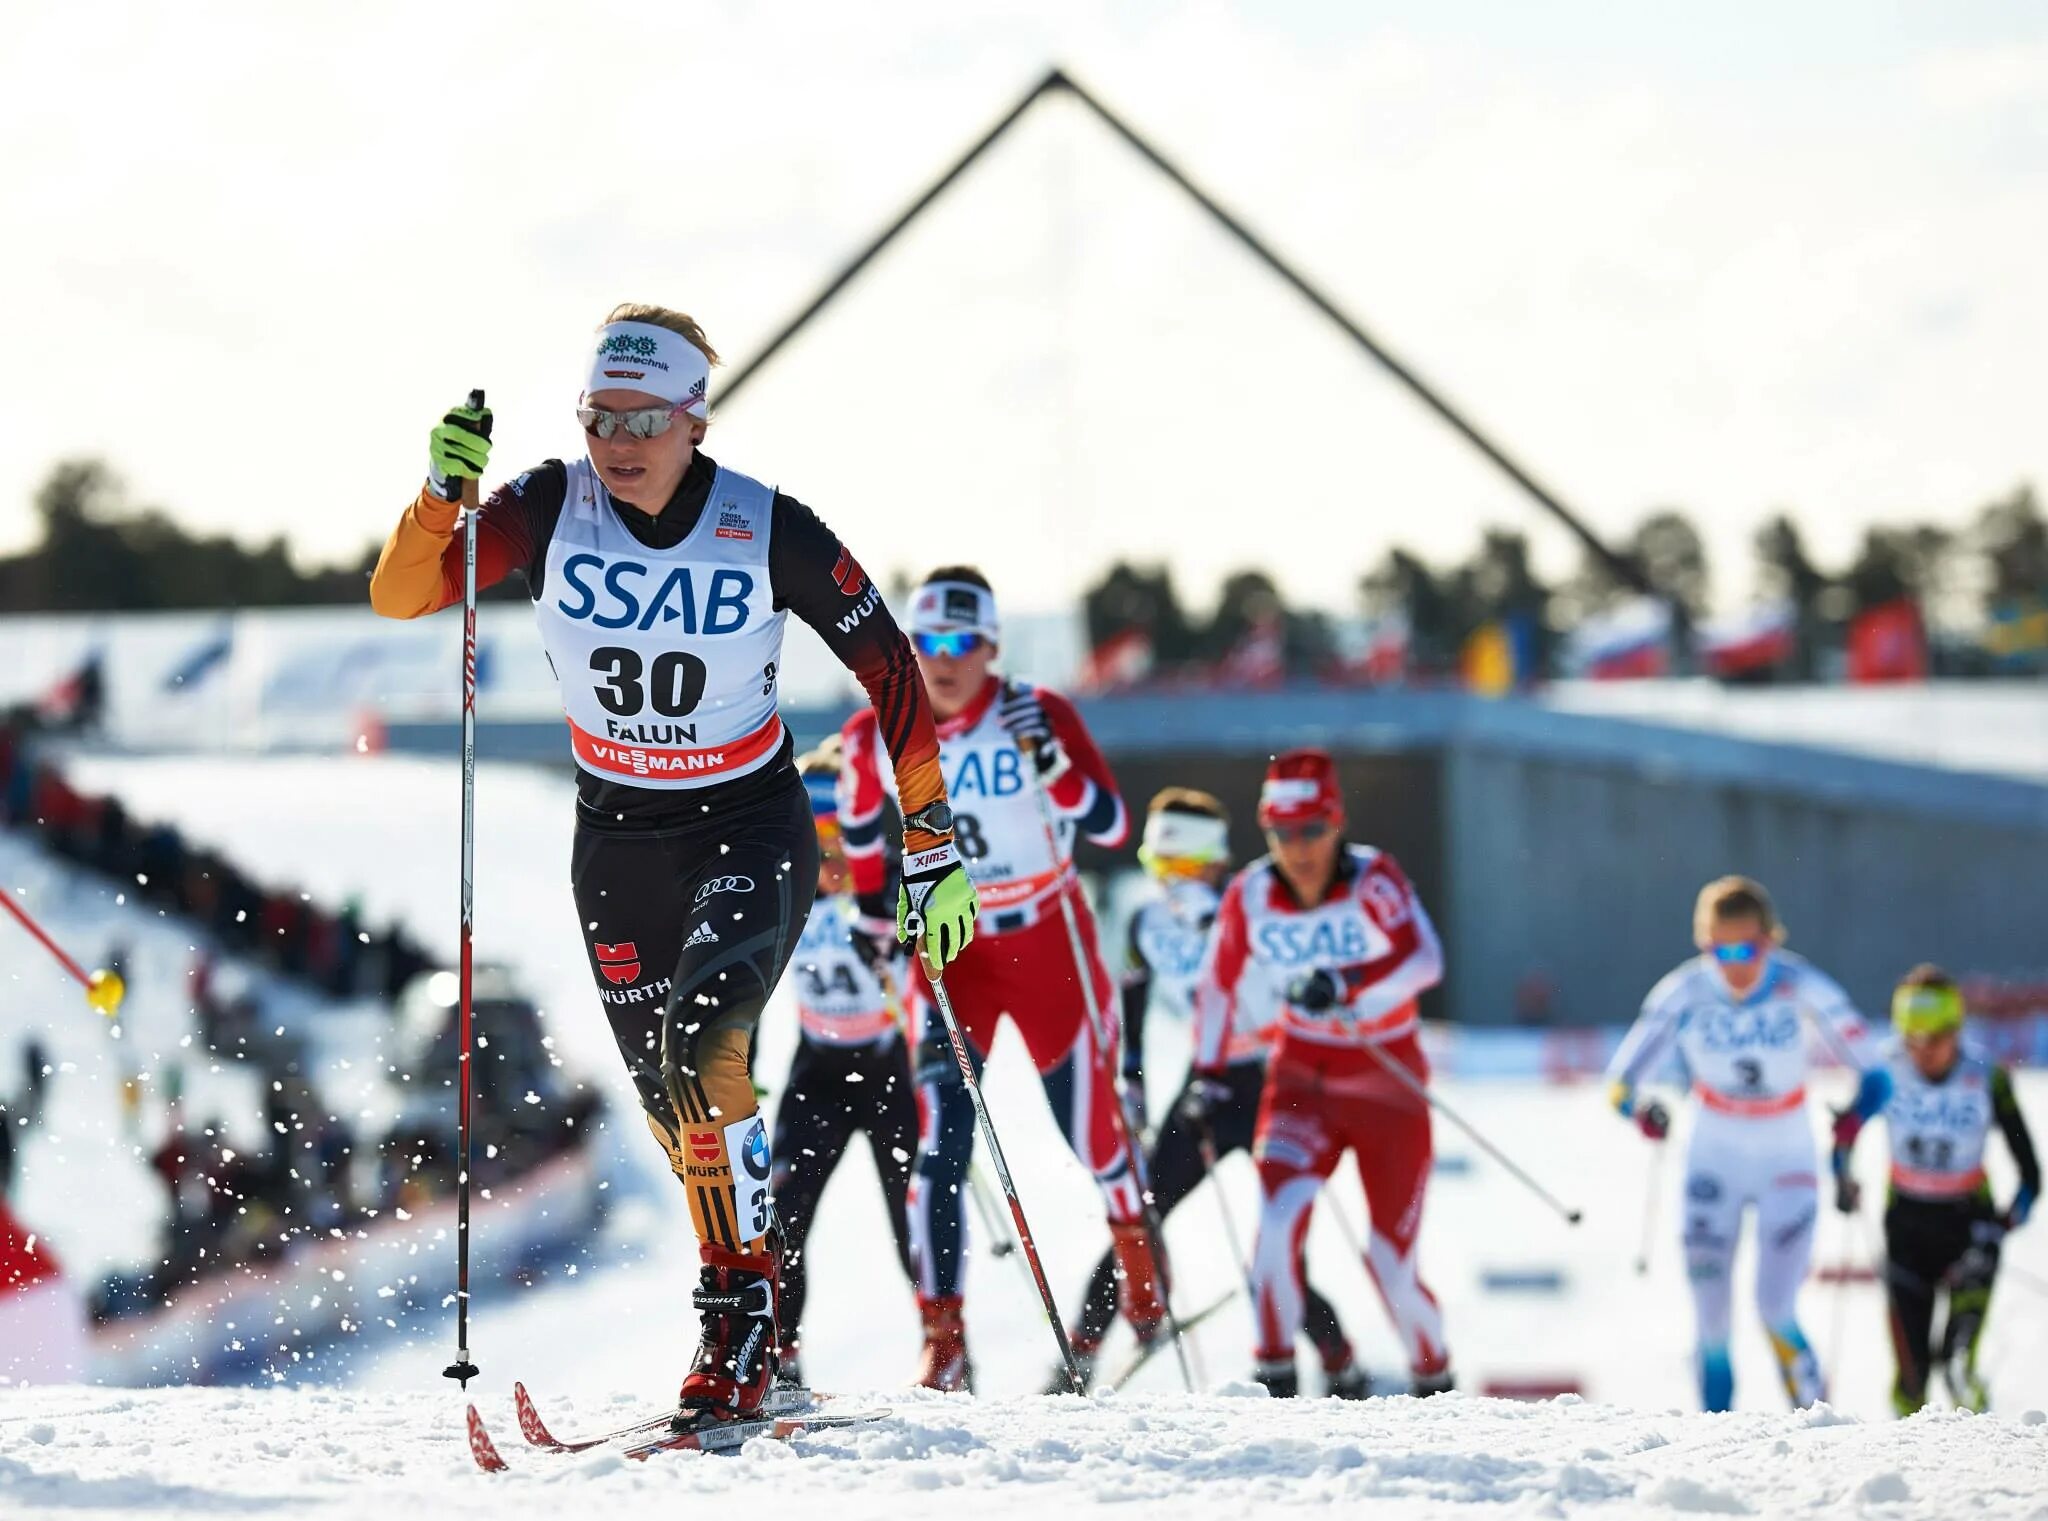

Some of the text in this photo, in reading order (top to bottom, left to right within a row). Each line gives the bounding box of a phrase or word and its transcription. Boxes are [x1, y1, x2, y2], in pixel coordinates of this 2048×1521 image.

[608, 353, 671, 373] Feintechnik
[720, 512, 742, 520] CROSS
[720, 517, 750, 526] COUNTRY
[558, 553, 754, 635] SSAB
[836, 584, 881, 634] WÜR
[589, 646, 707, 717] 30
[606, 718, 697, 744] FALUN
[942, 751, 1023, 798] AB
[954, 812, 988, 860] 8
[683, 932, 720, 951] adidas
[1258, 917, 1368, 965] SSAB
[598, 977, 673, 1005] WÜRTH
[686, 1164, 730, 1178] WÜRT
[751, 1187, 771, 1233] 3
[694, 1296, 742, 1304] ADSHUS
